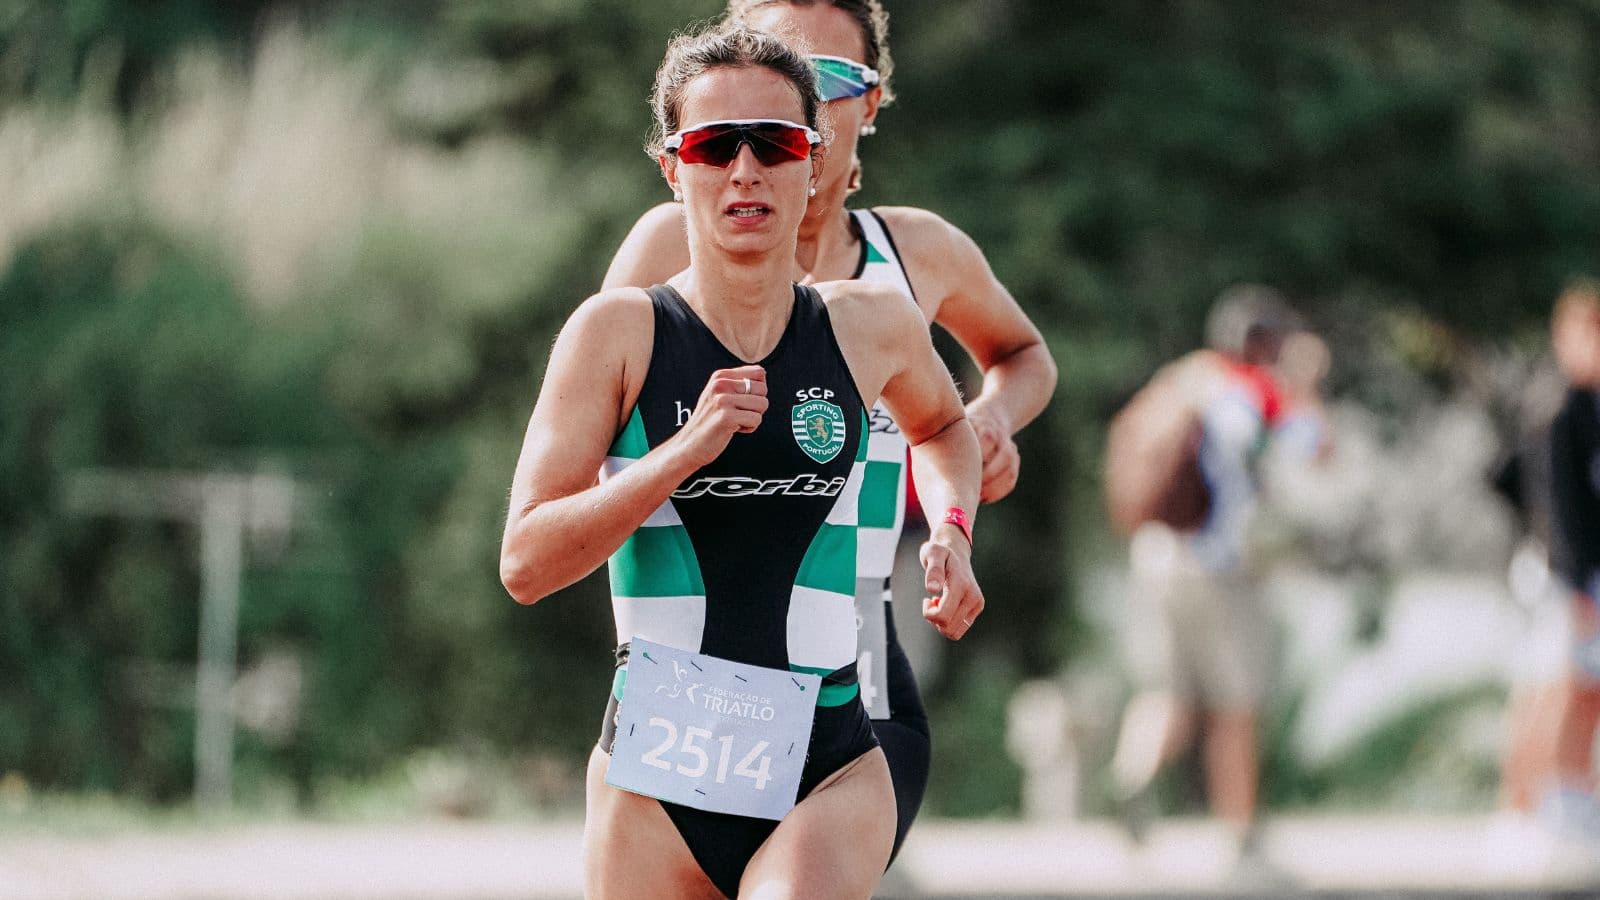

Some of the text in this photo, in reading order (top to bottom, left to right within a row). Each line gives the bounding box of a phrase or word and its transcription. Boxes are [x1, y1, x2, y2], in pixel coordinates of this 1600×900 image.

[796, 387, 835, 402] SCP
[674, 400, 692, 427] h
[796, 403, 840, 420] SPORTING
[802, 442, 841, 456] PORTUGAL
[702, 692, 775, 722] TRIATLO
[760, 696, 773, 705] DE
[641, 717, 773, 791] 2514
